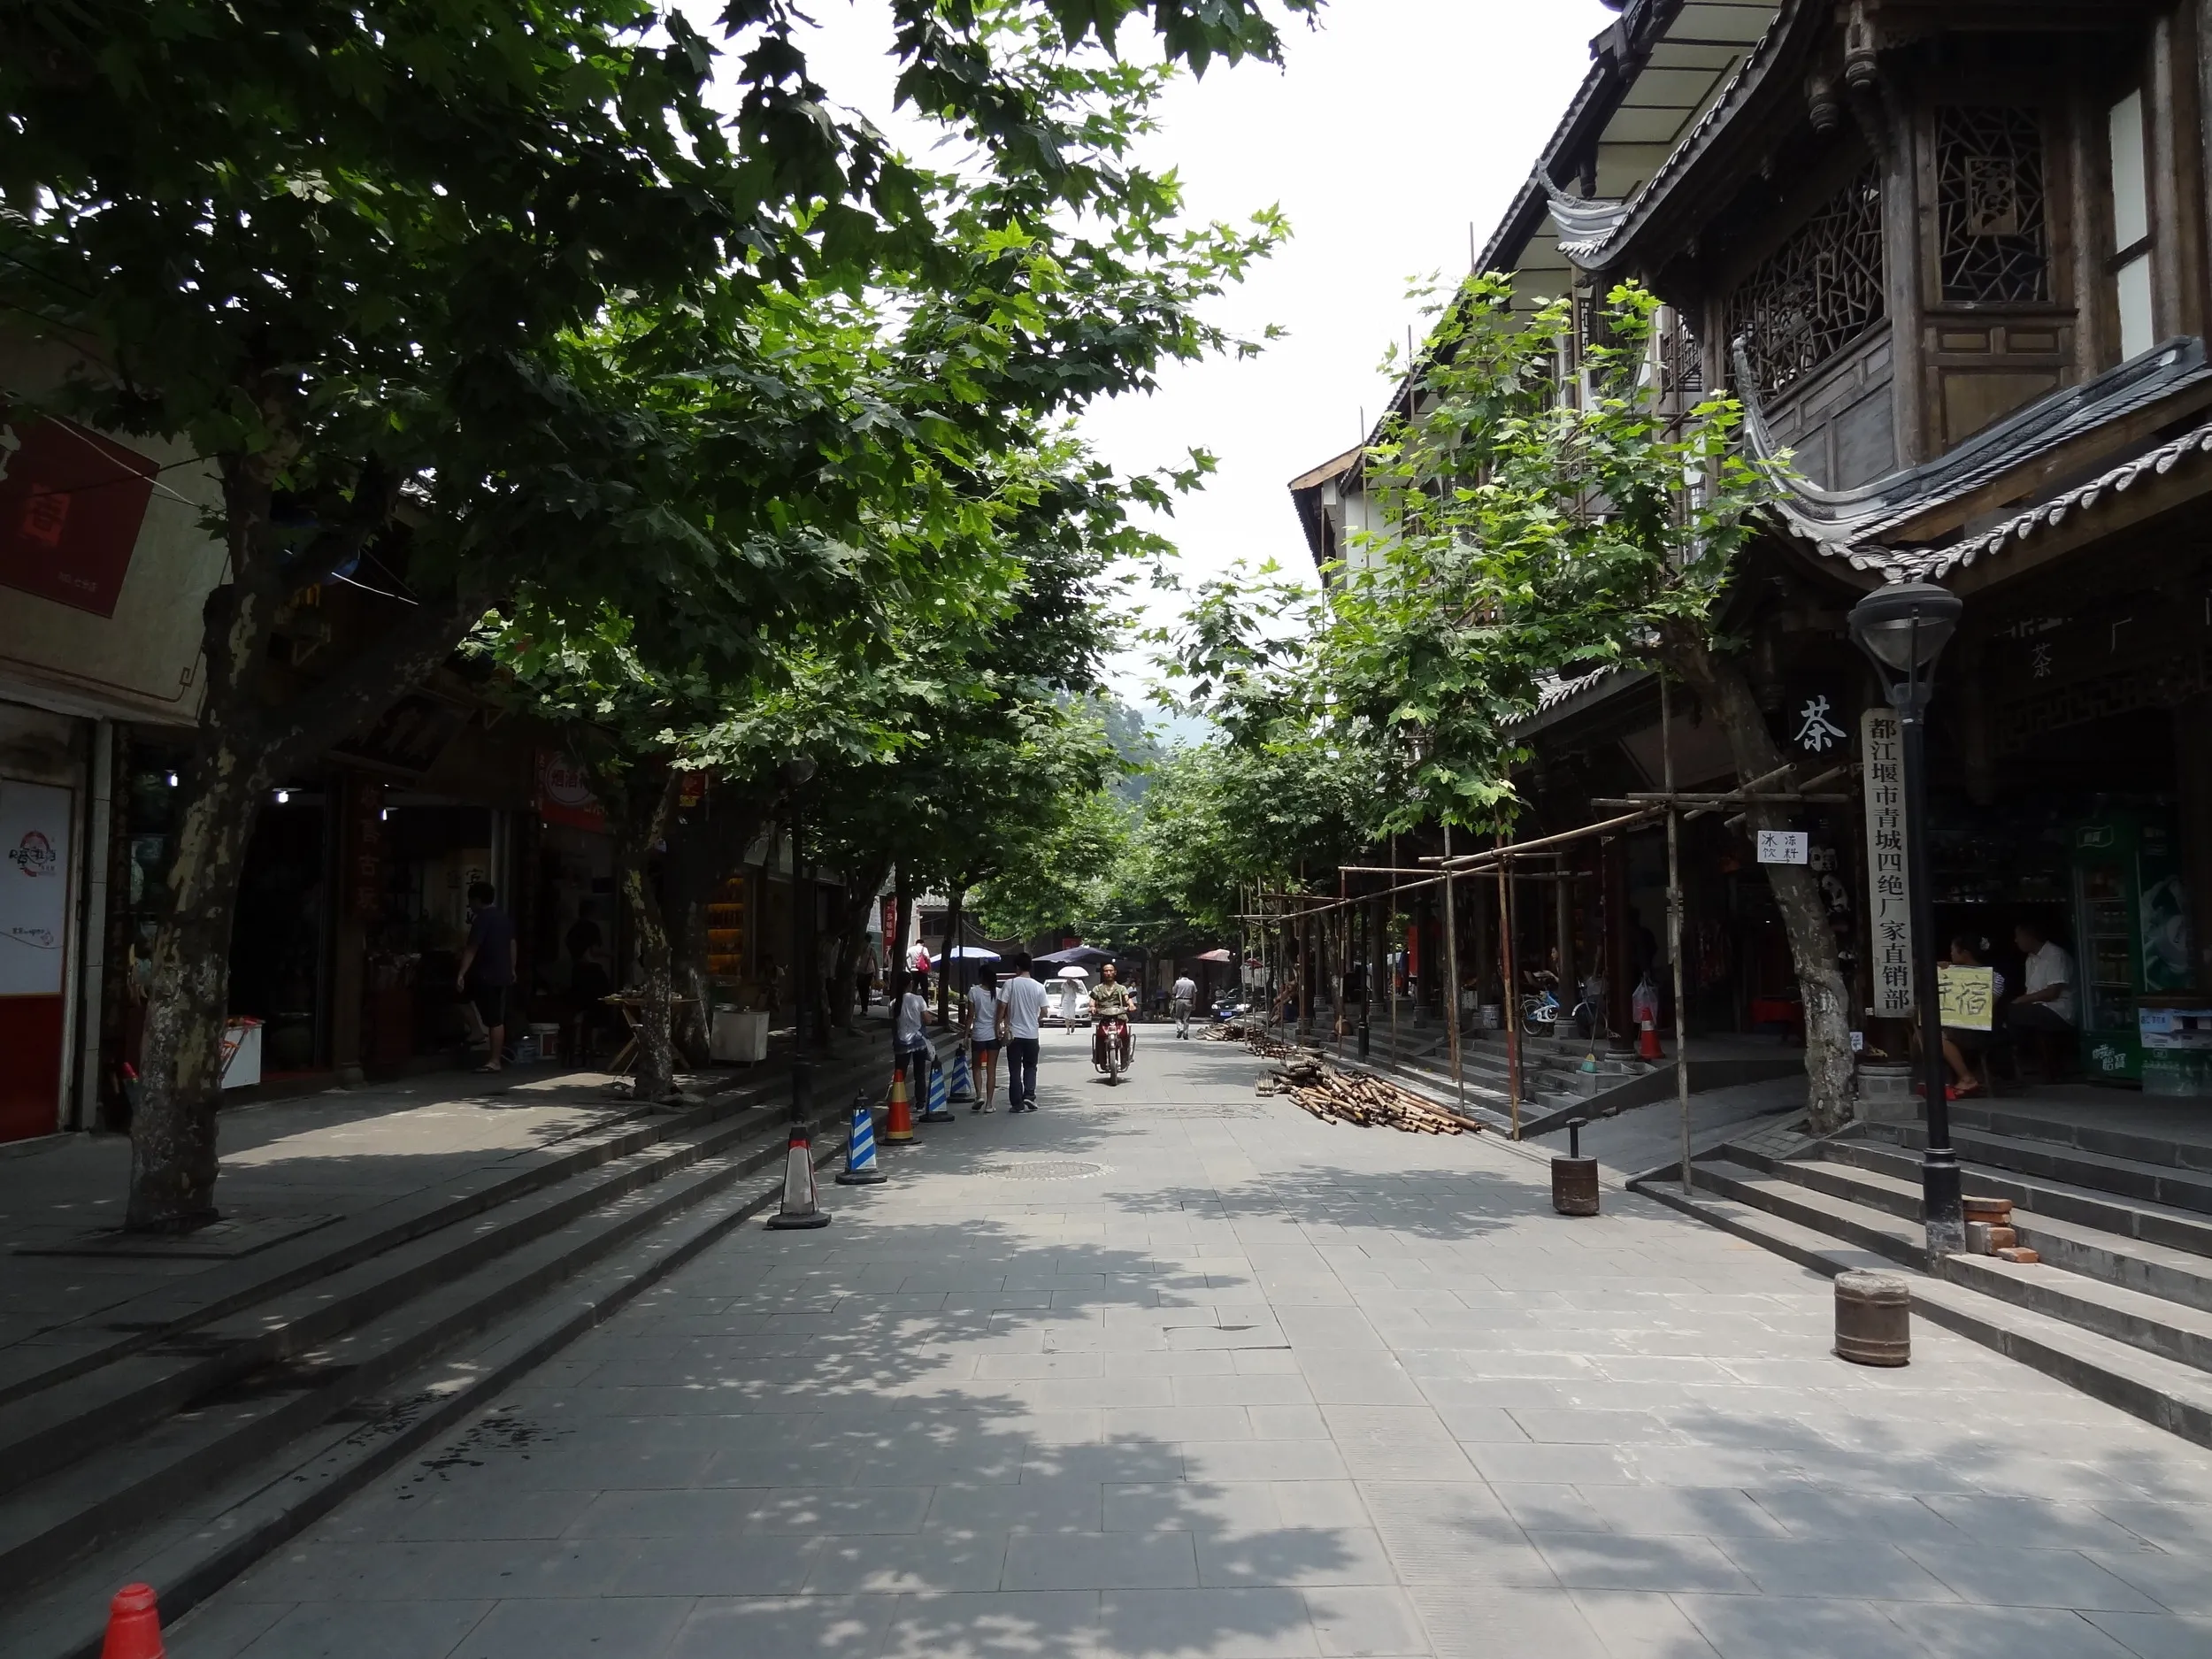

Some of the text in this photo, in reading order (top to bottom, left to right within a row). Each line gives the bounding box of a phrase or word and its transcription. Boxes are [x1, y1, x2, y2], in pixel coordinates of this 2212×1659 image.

[1793, 694, 1847, 752] 茶
[1762, 833, 1797, 848] 冰冻
[1763, 847, 1799, 859] 饮料
[1869, 718, 1910, 1010] 都江堰市青城四绝厂家直销部
